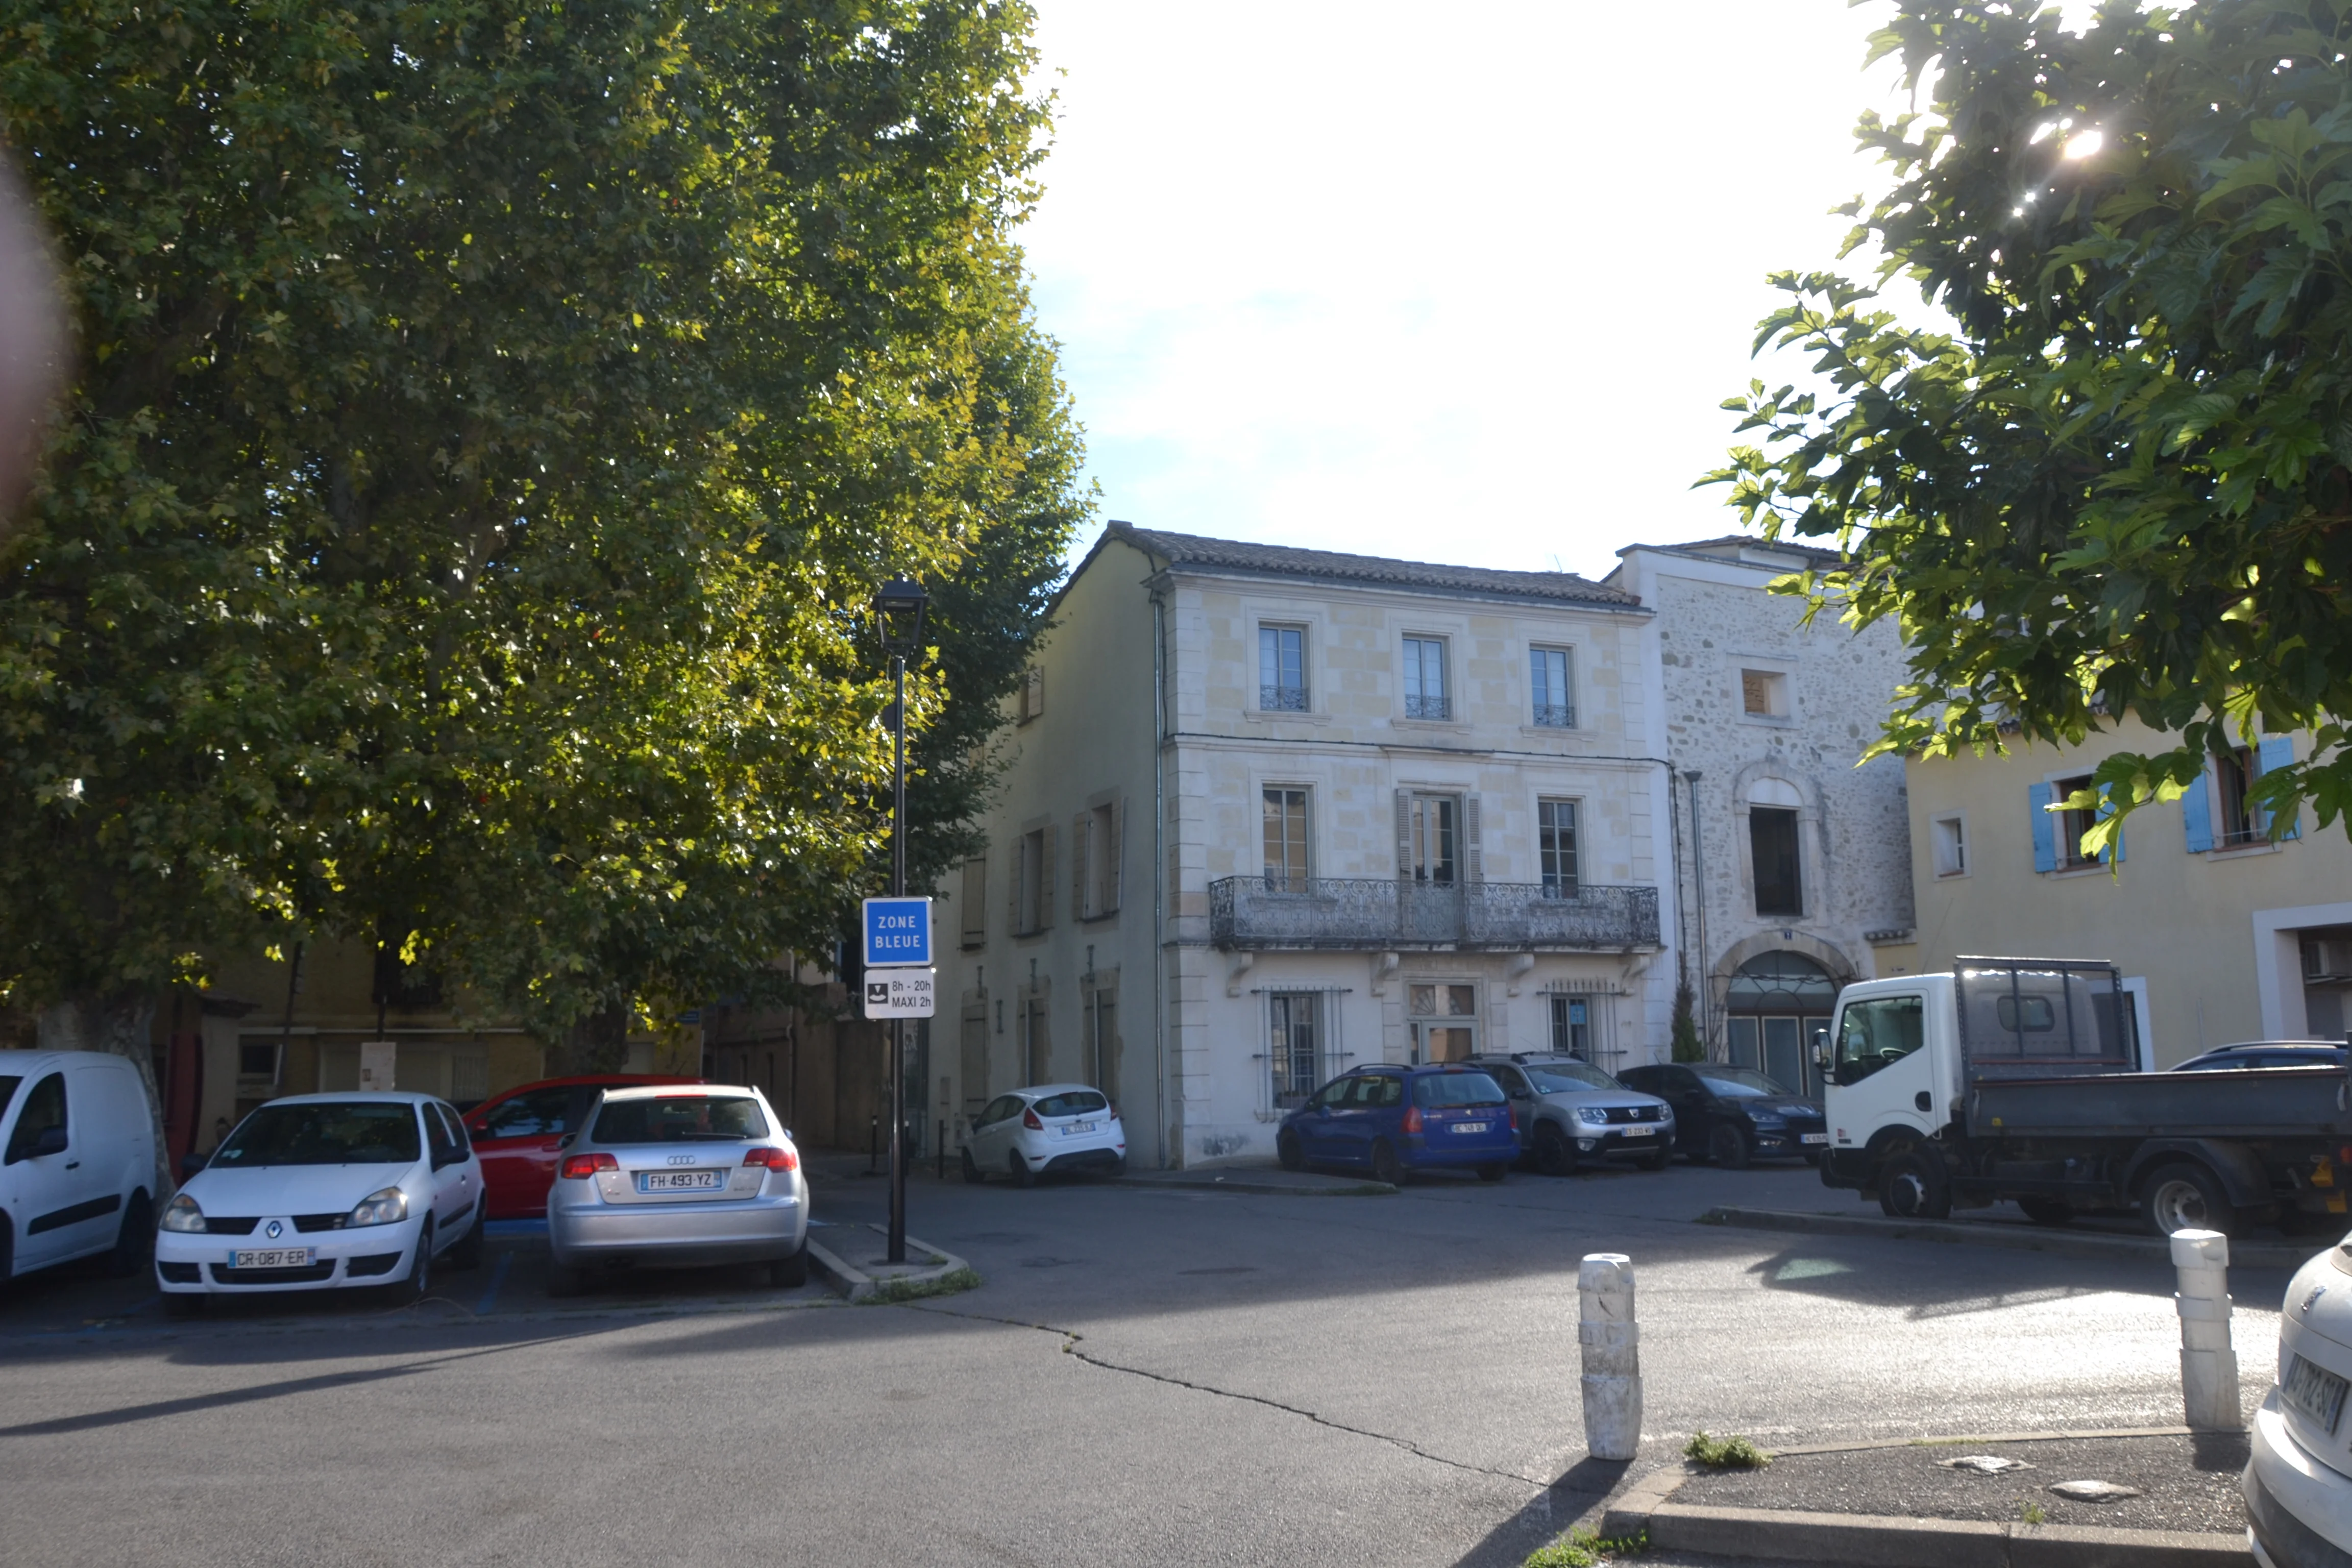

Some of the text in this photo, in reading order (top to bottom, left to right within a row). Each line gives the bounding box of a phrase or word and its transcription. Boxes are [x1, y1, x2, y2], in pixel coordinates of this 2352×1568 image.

[878, 916, 916, 928] ZONE
[875, 935, 920, 948] BLEUE
[892, 981, 903, 991] 8h
[914, 981, 931, 991] 20h
[892, 996, 931, 1008] MAXI 2h
[650, 1174, 711, 1188] FH-493-YZ
[237, 1251, 305, 1266] CR-087-ER
